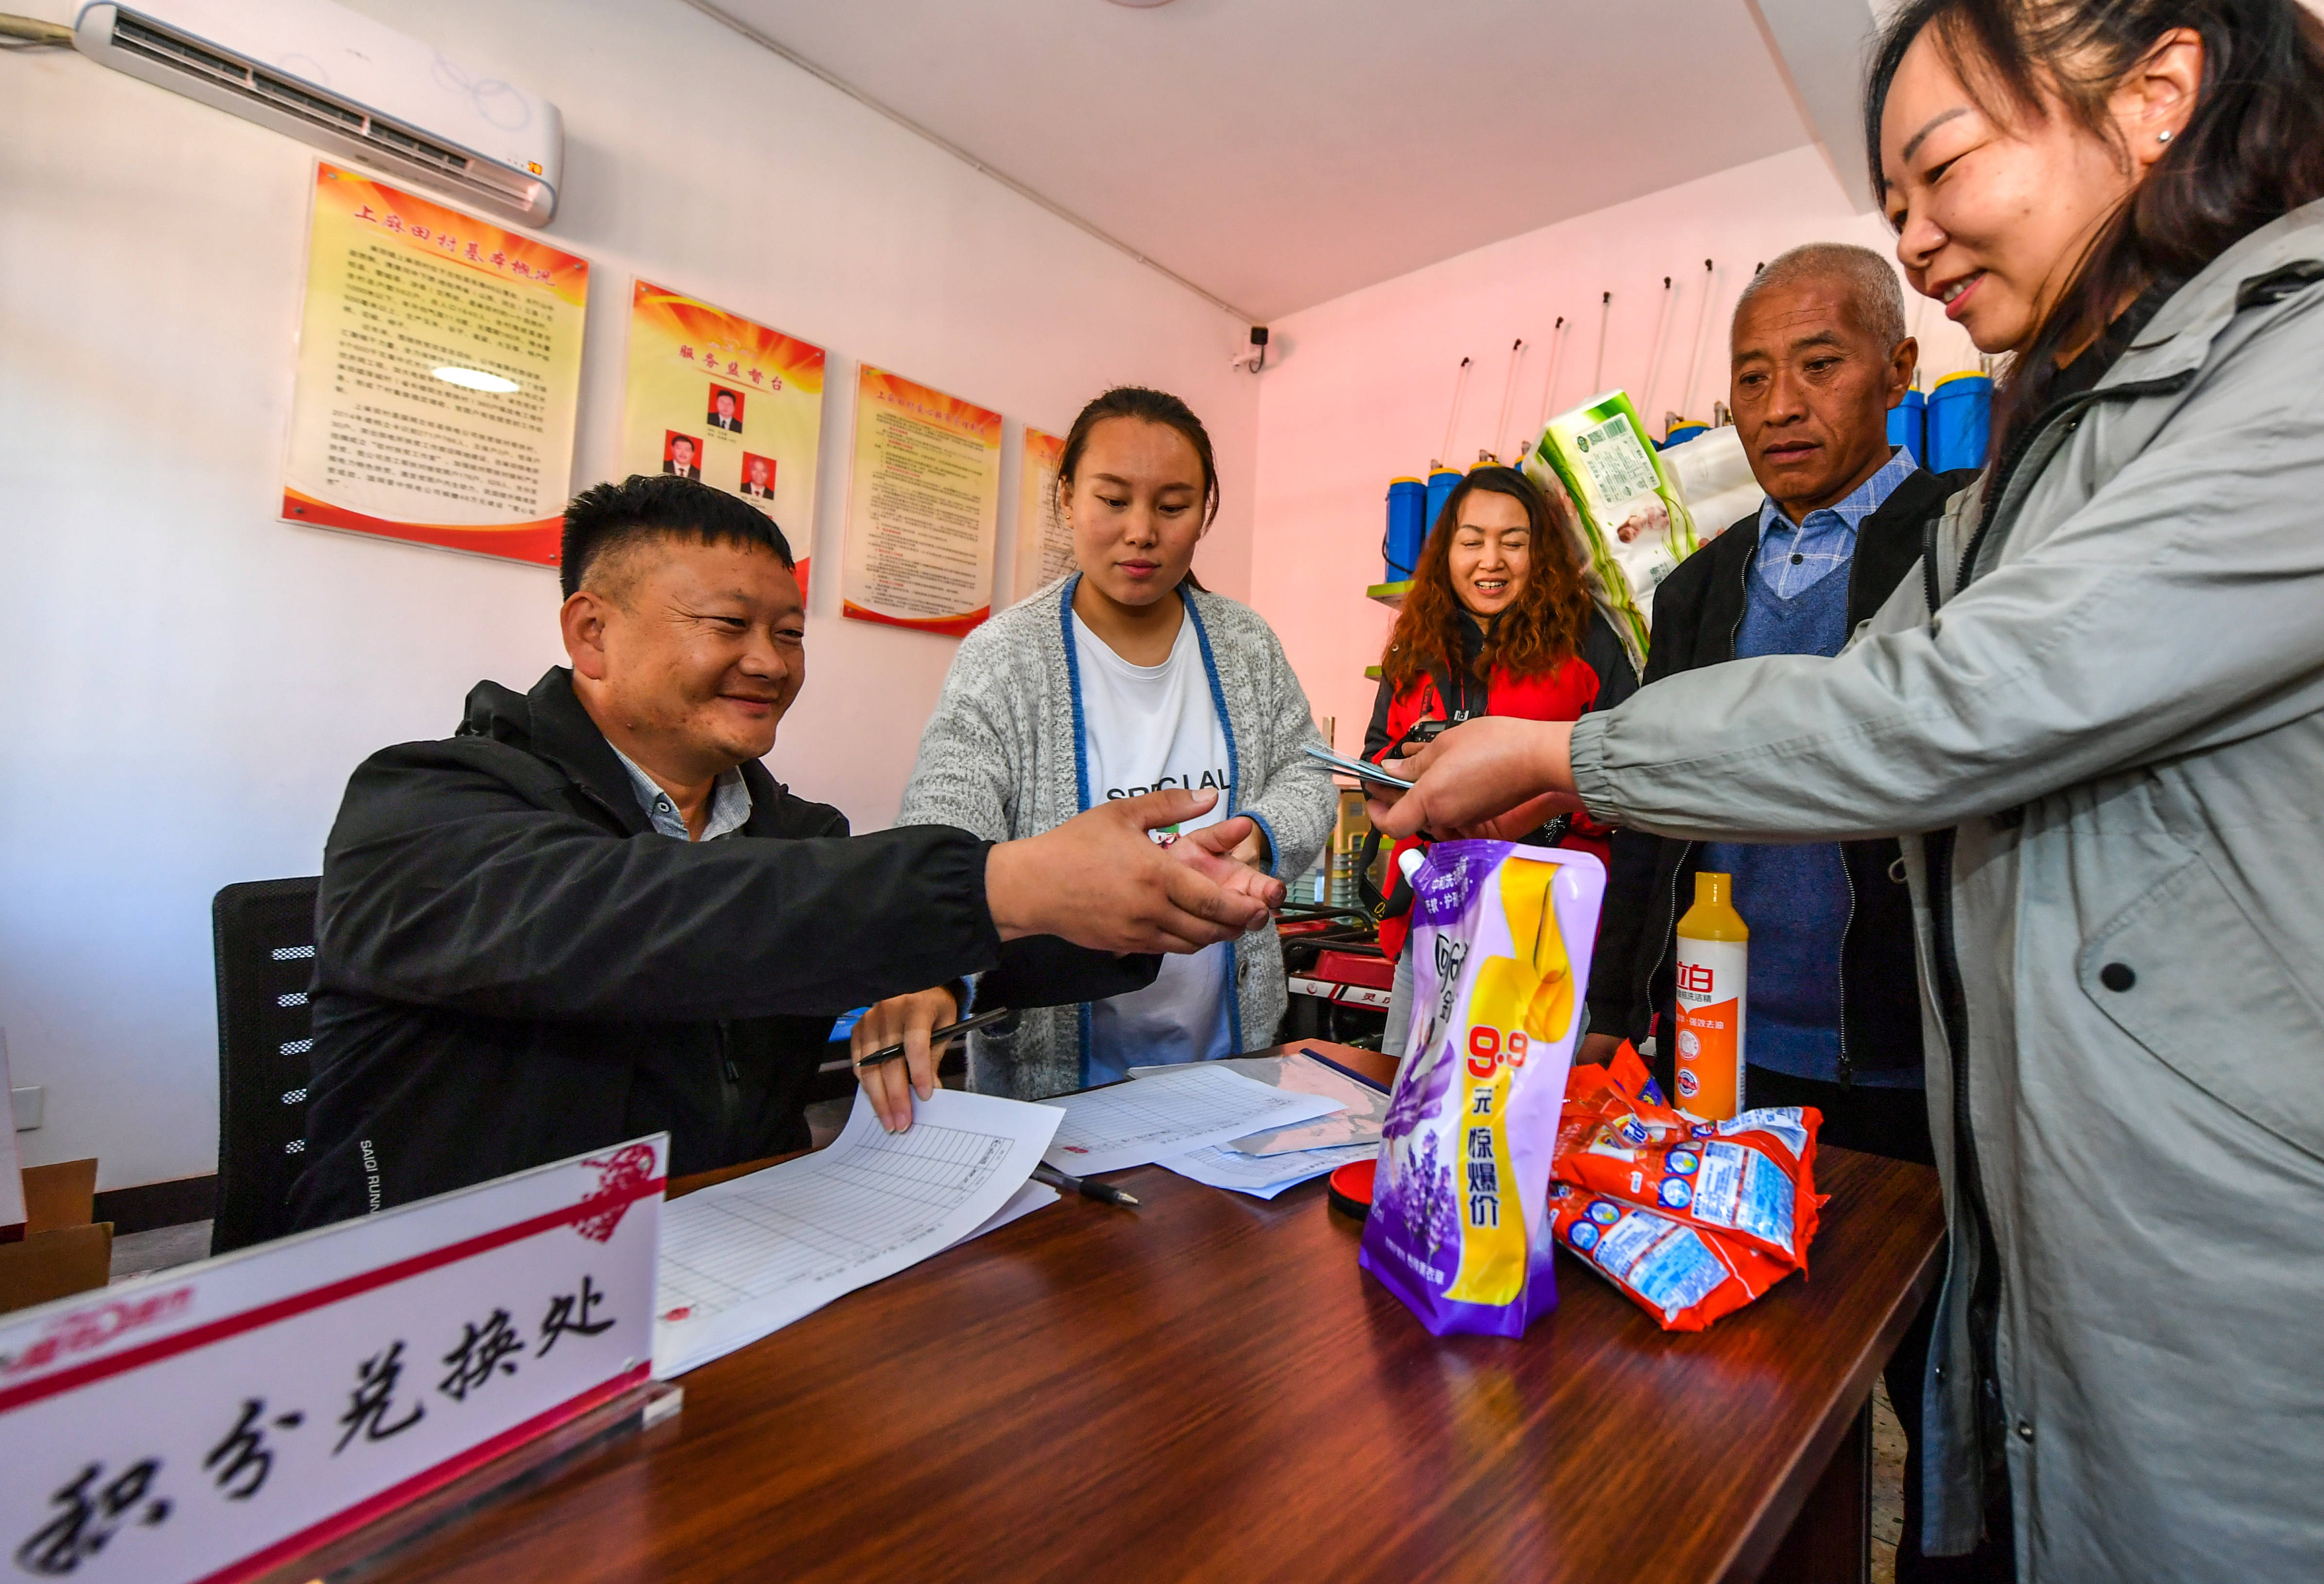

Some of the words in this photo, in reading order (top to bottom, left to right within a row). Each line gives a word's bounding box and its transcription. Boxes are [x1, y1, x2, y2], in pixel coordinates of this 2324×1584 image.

[354, 204, 555, 287] 上麻田村基本概况
[680, 344, 783, 391] 服务监督台
[1468, 1025, 1528, 1079] 9.9
[1467, 1127, 1498, 1227] 惊爆价
[17, 1275, 616, 1577] 积分兑换处
